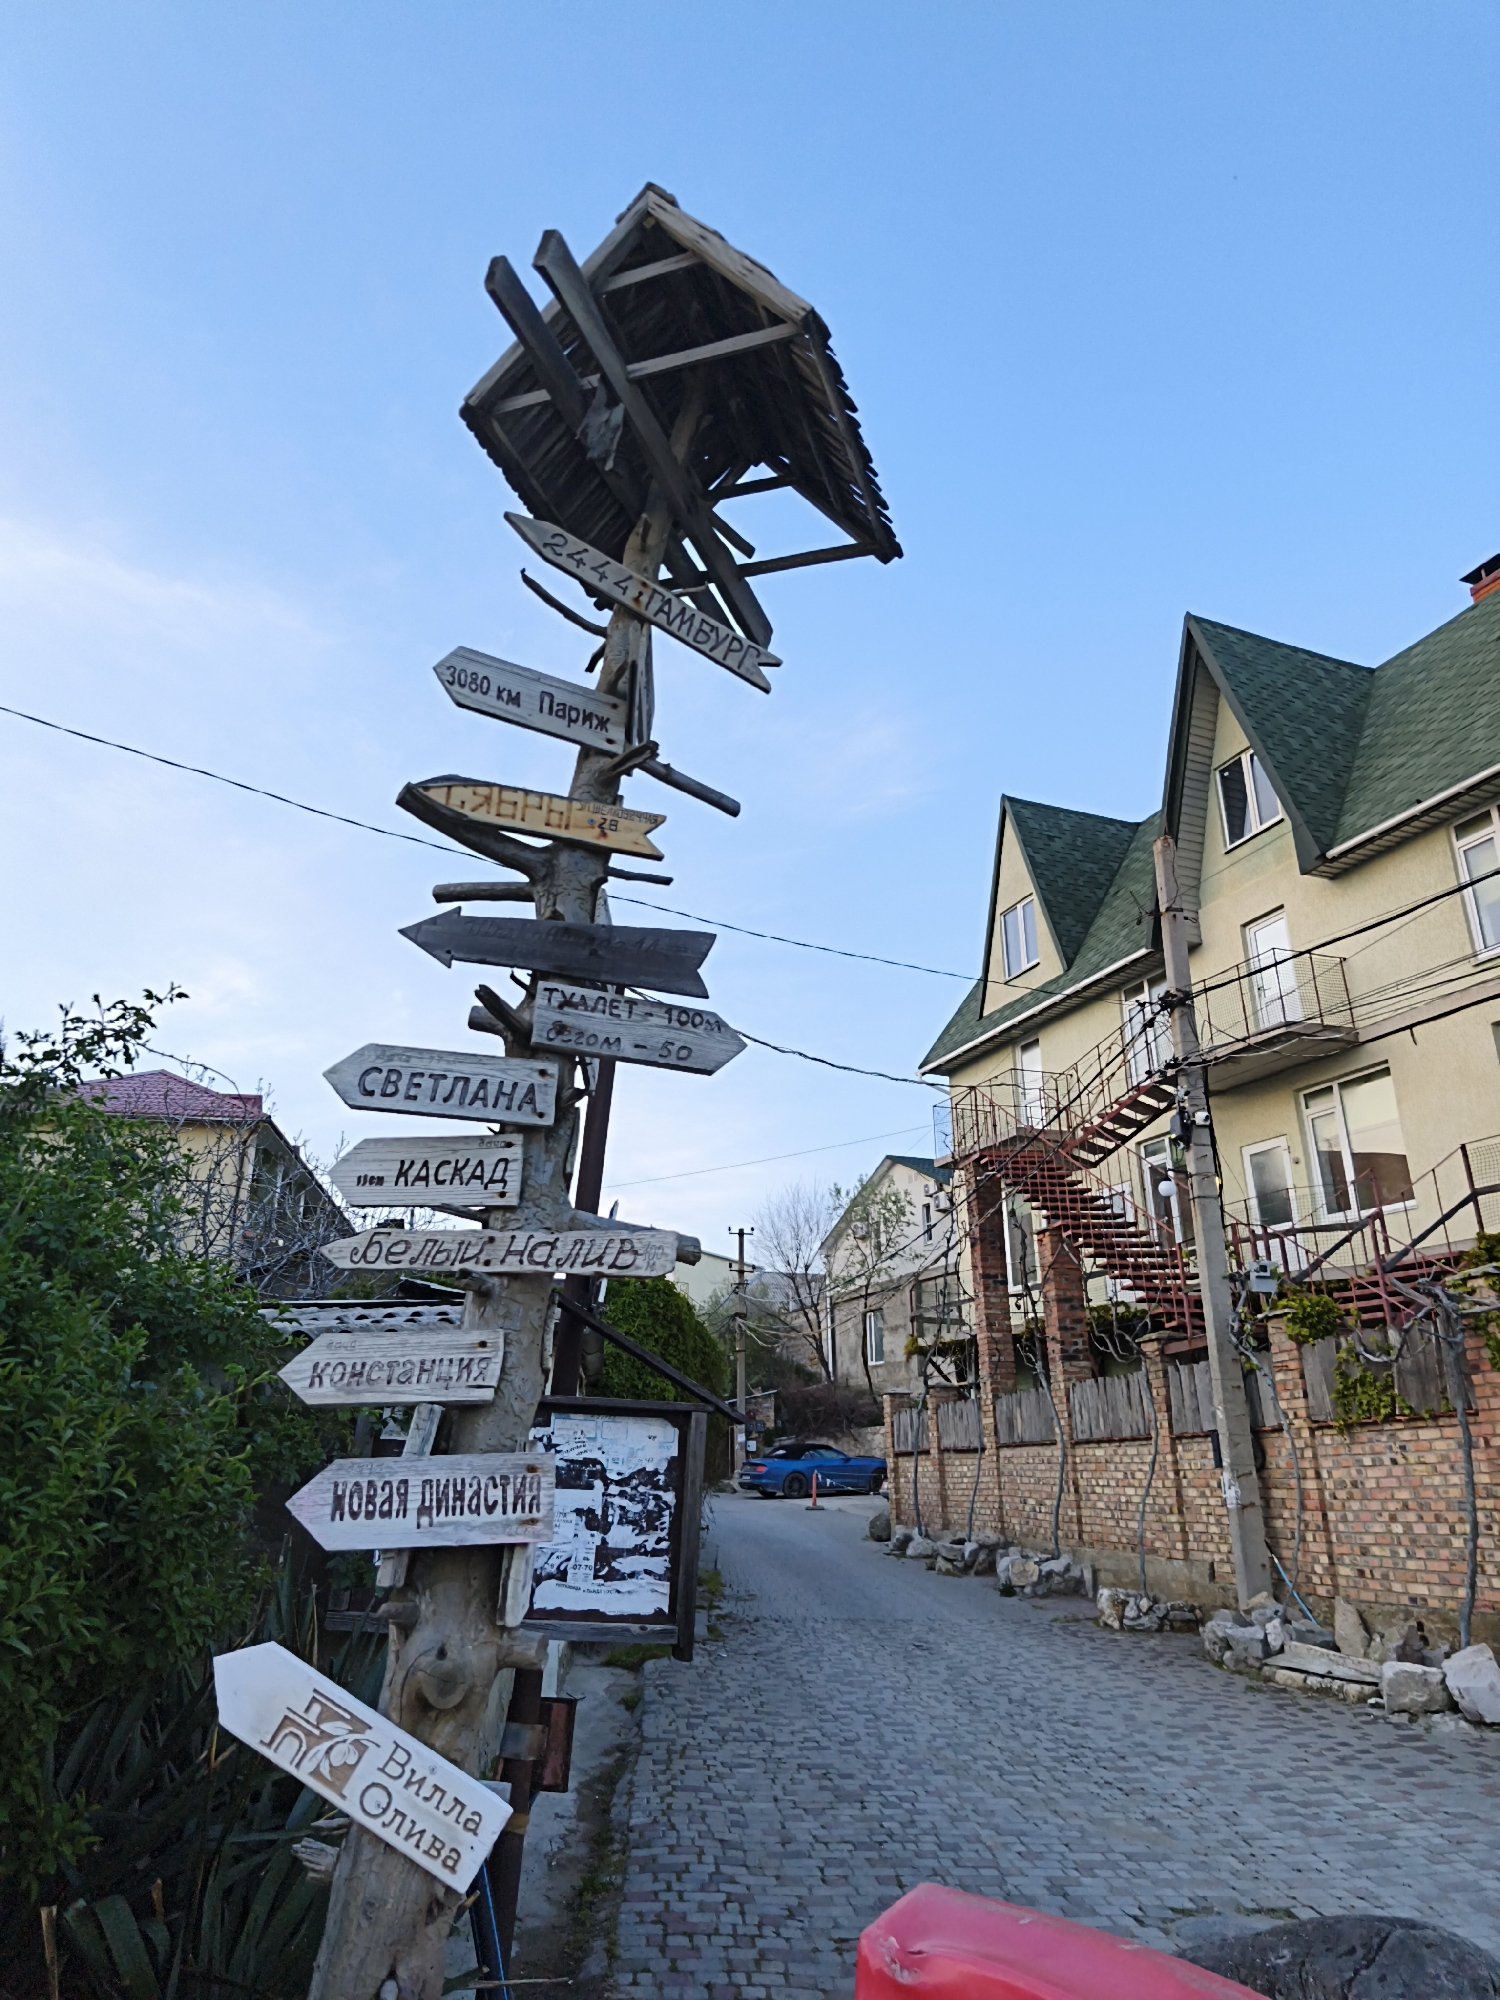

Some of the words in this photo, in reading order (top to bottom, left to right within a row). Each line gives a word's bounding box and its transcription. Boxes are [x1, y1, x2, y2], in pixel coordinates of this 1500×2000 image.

[542, 532, 634, 597] 2444
[643, 588, 762, 669] ГАМБУРГ
[446, 665, 491, 696] 3080
[496, 685, 521, 708] км
[538, 690, 612, 734] Париж
[597, 817, 619, 832] 28
[542, 986, 639, 1019] ТУАЛЕТ
[658, 1039, 693, 1061] 50
[357, 1067, 538, 1113] СВЕТЛАНА
[394, 1157, 510, 1191] КАСКАД
[376, 1740, 483, 1836] Вилла
[358, 1781, 463, 1875] Олива
